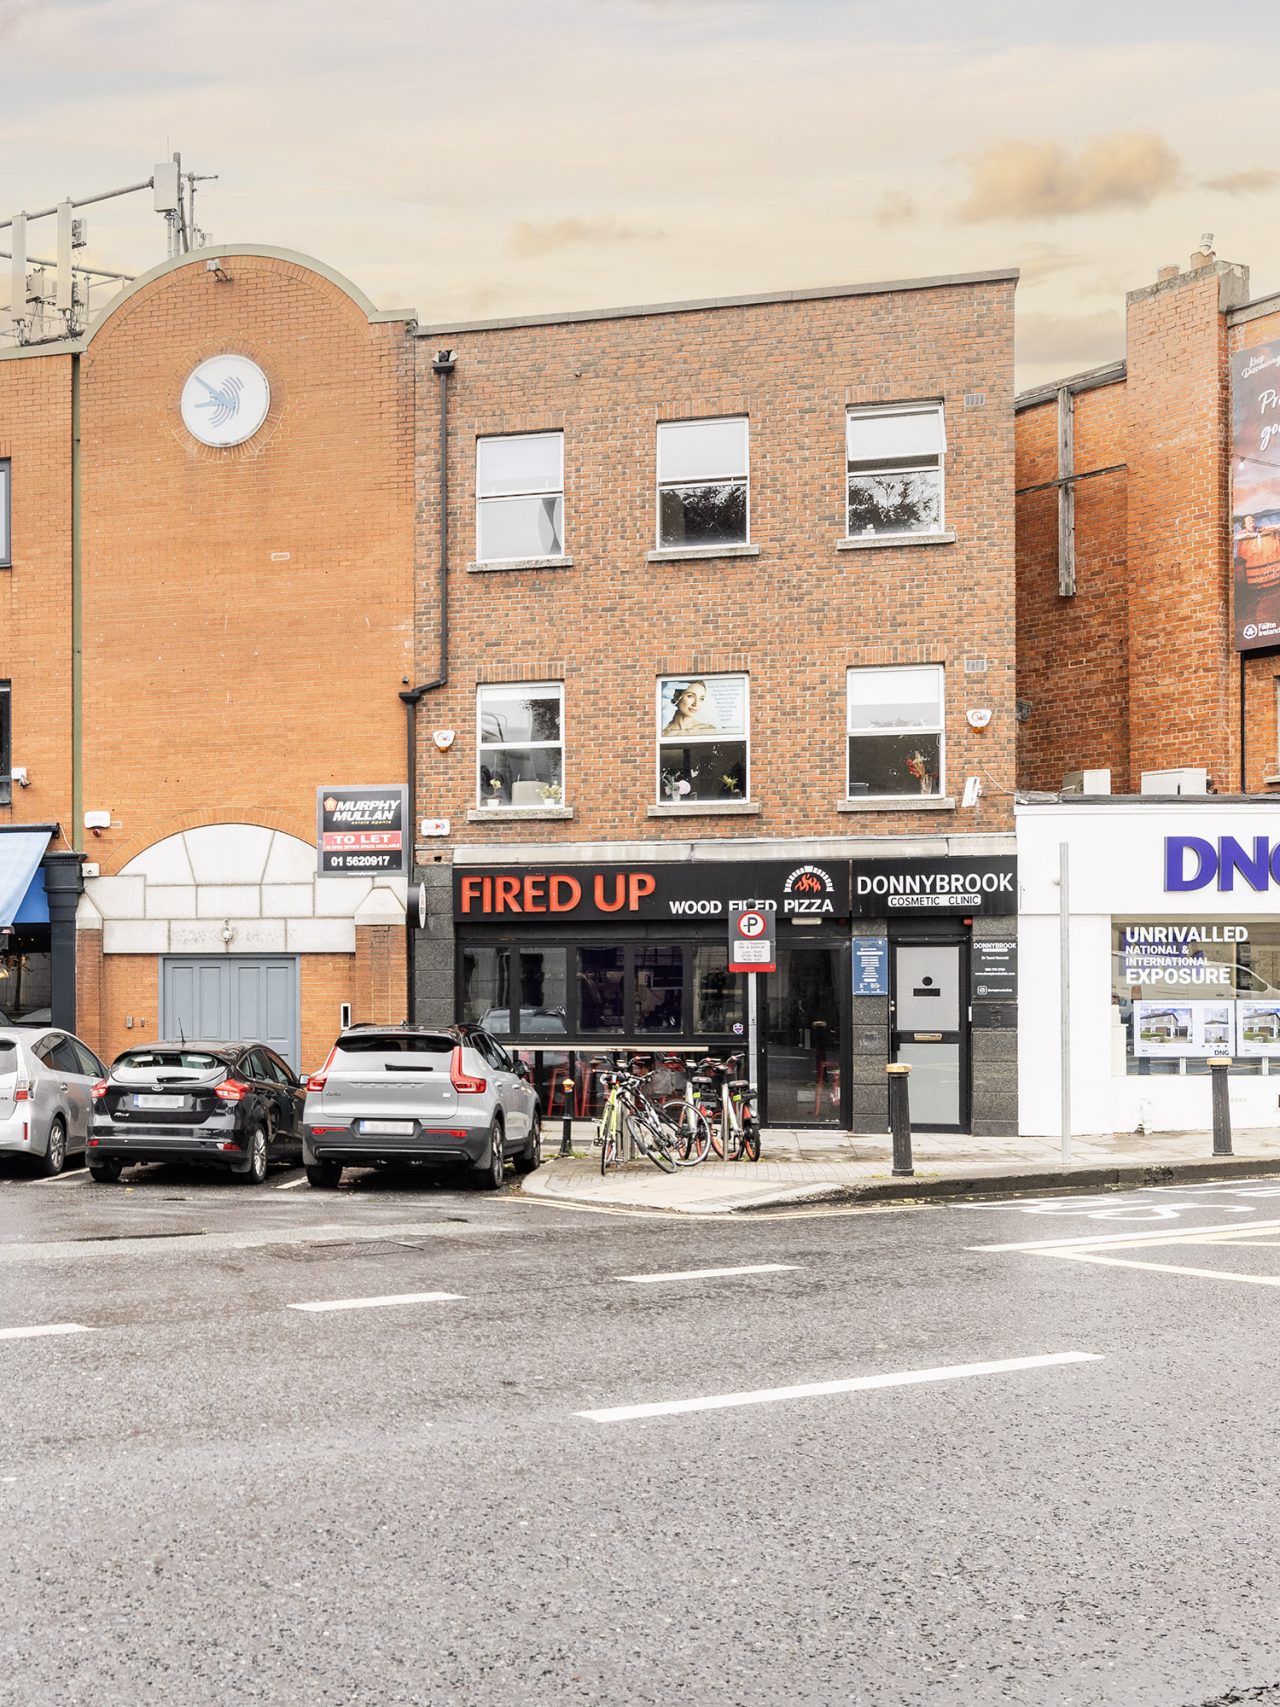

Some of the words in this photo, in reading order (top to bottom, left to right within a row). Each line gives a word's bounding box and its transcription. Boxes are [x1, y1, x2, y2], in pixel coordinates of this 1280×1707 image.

[1258, 389, 1280, 415] Pr
[1260, 423, 1280, 451] go
[336, 800, 401, 811] MURPHY
[333, 810, 394, 821] MULLAN
[334, 835, 355, 844] TO
[361, 834, 391, 844] LET
[330, 856, 343, 867] 01
[346, 855, 390, 866] 5620917
[1164, 836, 1280, 892] DN
[857, 872, 1014, 895] DONNYBROOK
[461, 875, 582, 913] FIRED
[594, 872, 656, 913] UP
[890, 896, 940, 906] COSMETIC
[948, 895, 980, 905] CLINIC
[669, 900, 722, 914] WOOD
[784, 898, 834, 913] PIZZA
[1125, 926, 1249, 943] UNRIVALLED
[1125, 945, 1179, 954] NATIONAL
[1181, 945, 1189, 954] &
[1125, 957, 1211, 966] INTERNATIONAL
[1125, 968, 1231, 984] EXPOSURE
